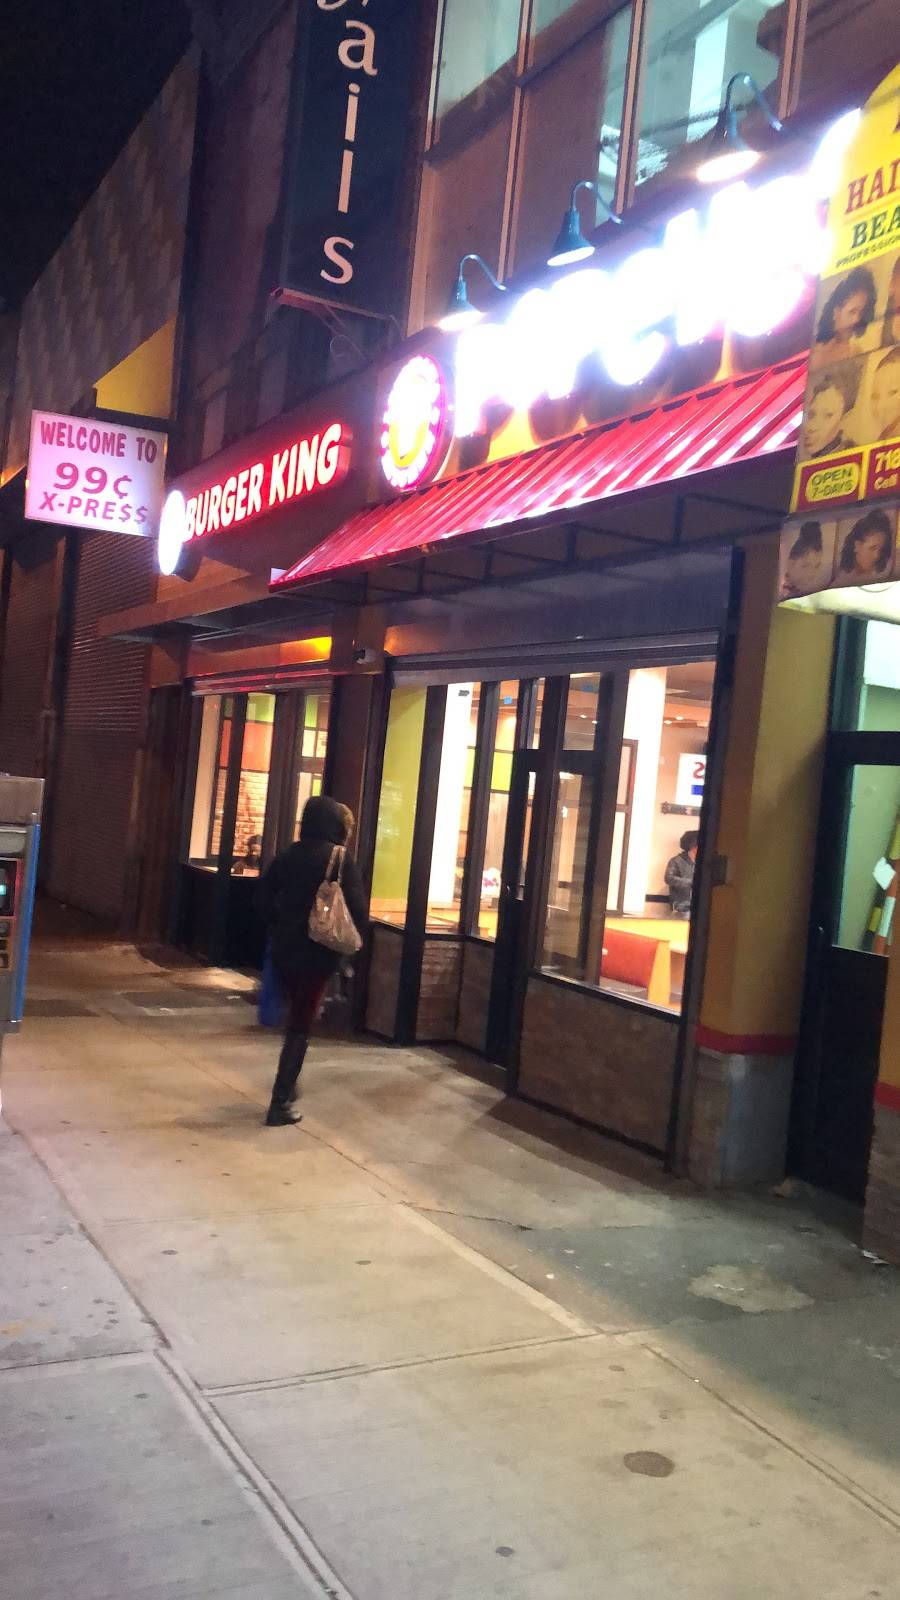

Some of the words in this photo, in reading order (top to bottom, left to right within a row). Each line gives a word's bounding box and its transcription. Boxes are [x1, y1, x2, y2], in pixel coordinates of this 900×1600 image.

[40, 420, 127, 458] WELCOME
[135, 436, 158, 464] TO
[182, 463, 264, 543] BURGER
[268, 423, 342, 506] KING
[811, 467, 853, 485] OPEN
[38, 491, 149, 525] X-PRE$$
